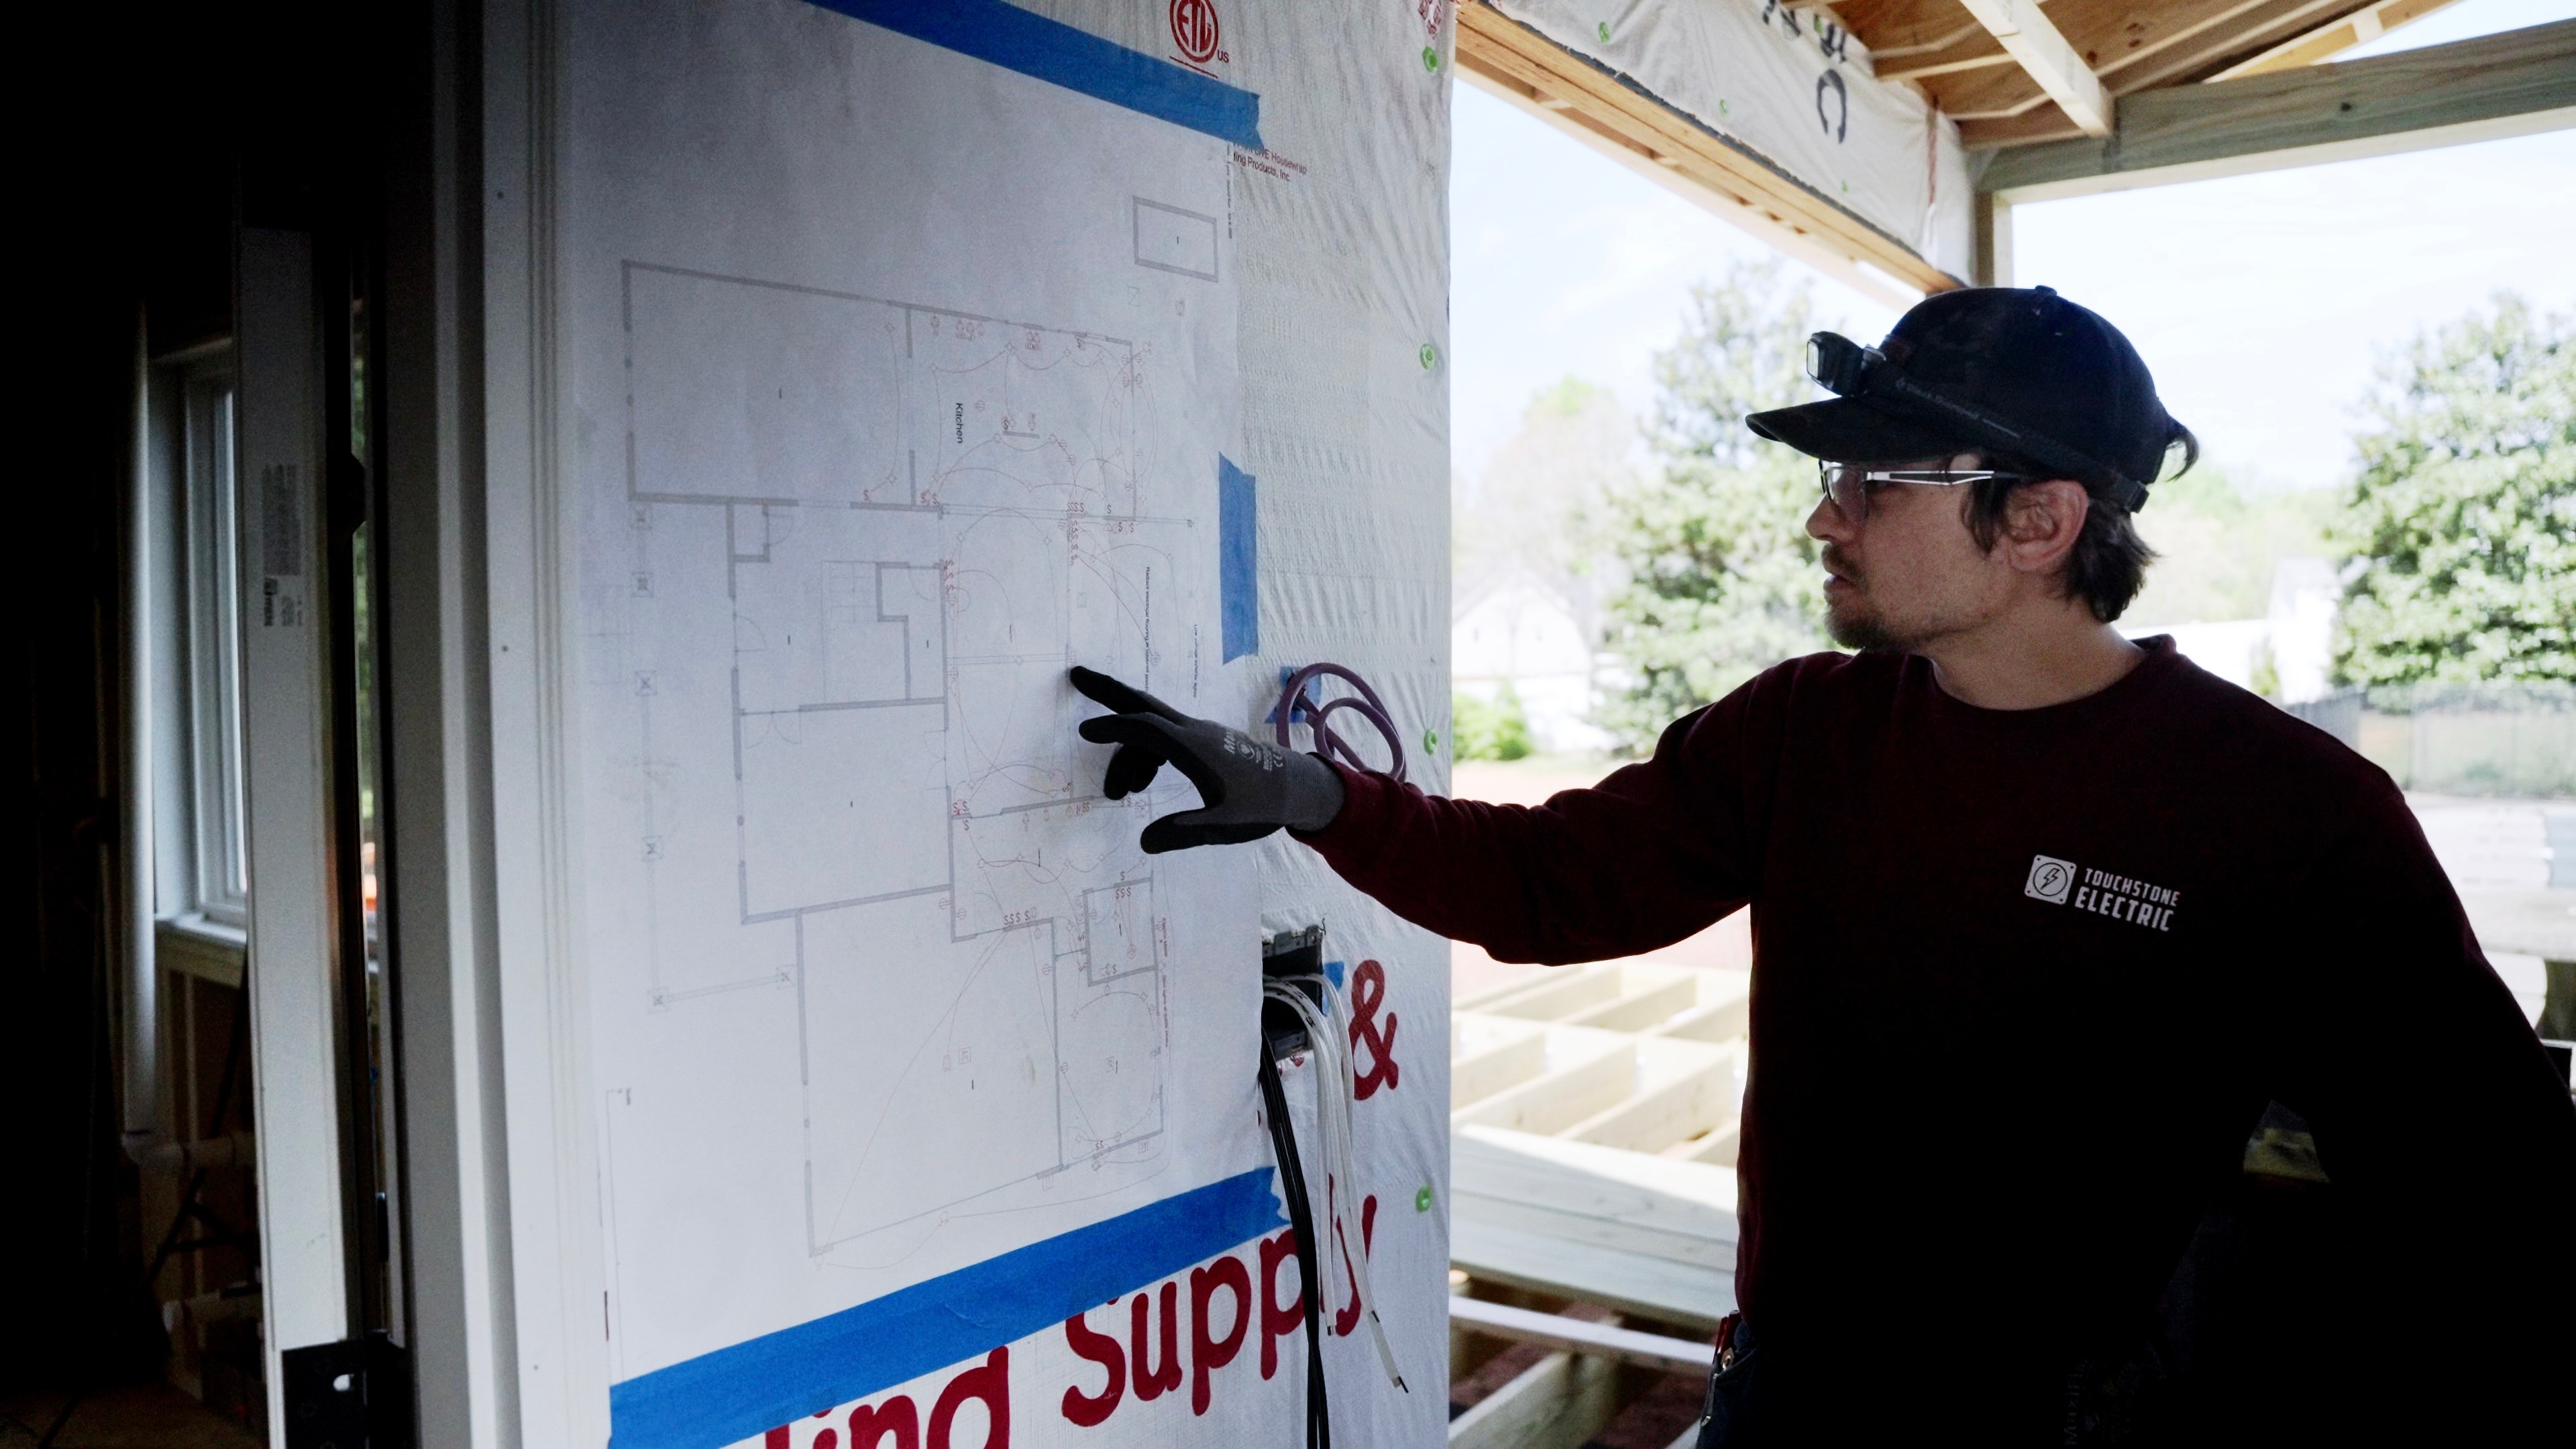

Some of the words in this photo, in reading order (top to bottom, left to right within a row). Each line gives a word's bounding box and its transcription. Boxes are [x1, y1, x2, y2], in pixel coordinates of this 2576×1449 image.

[1218, 50, 1229, 63] US
[1248, 157, 1279, 177] Products,
[1280, 169, 1291, 182] Inc.
[955, 402, 963, 443] Kitchen
[2084, 867, 2180, 907] TOUCHSTONE
[2074, 885, 2175, 932] ELECTRIC
[1347, 959, 1399, 1100] &
